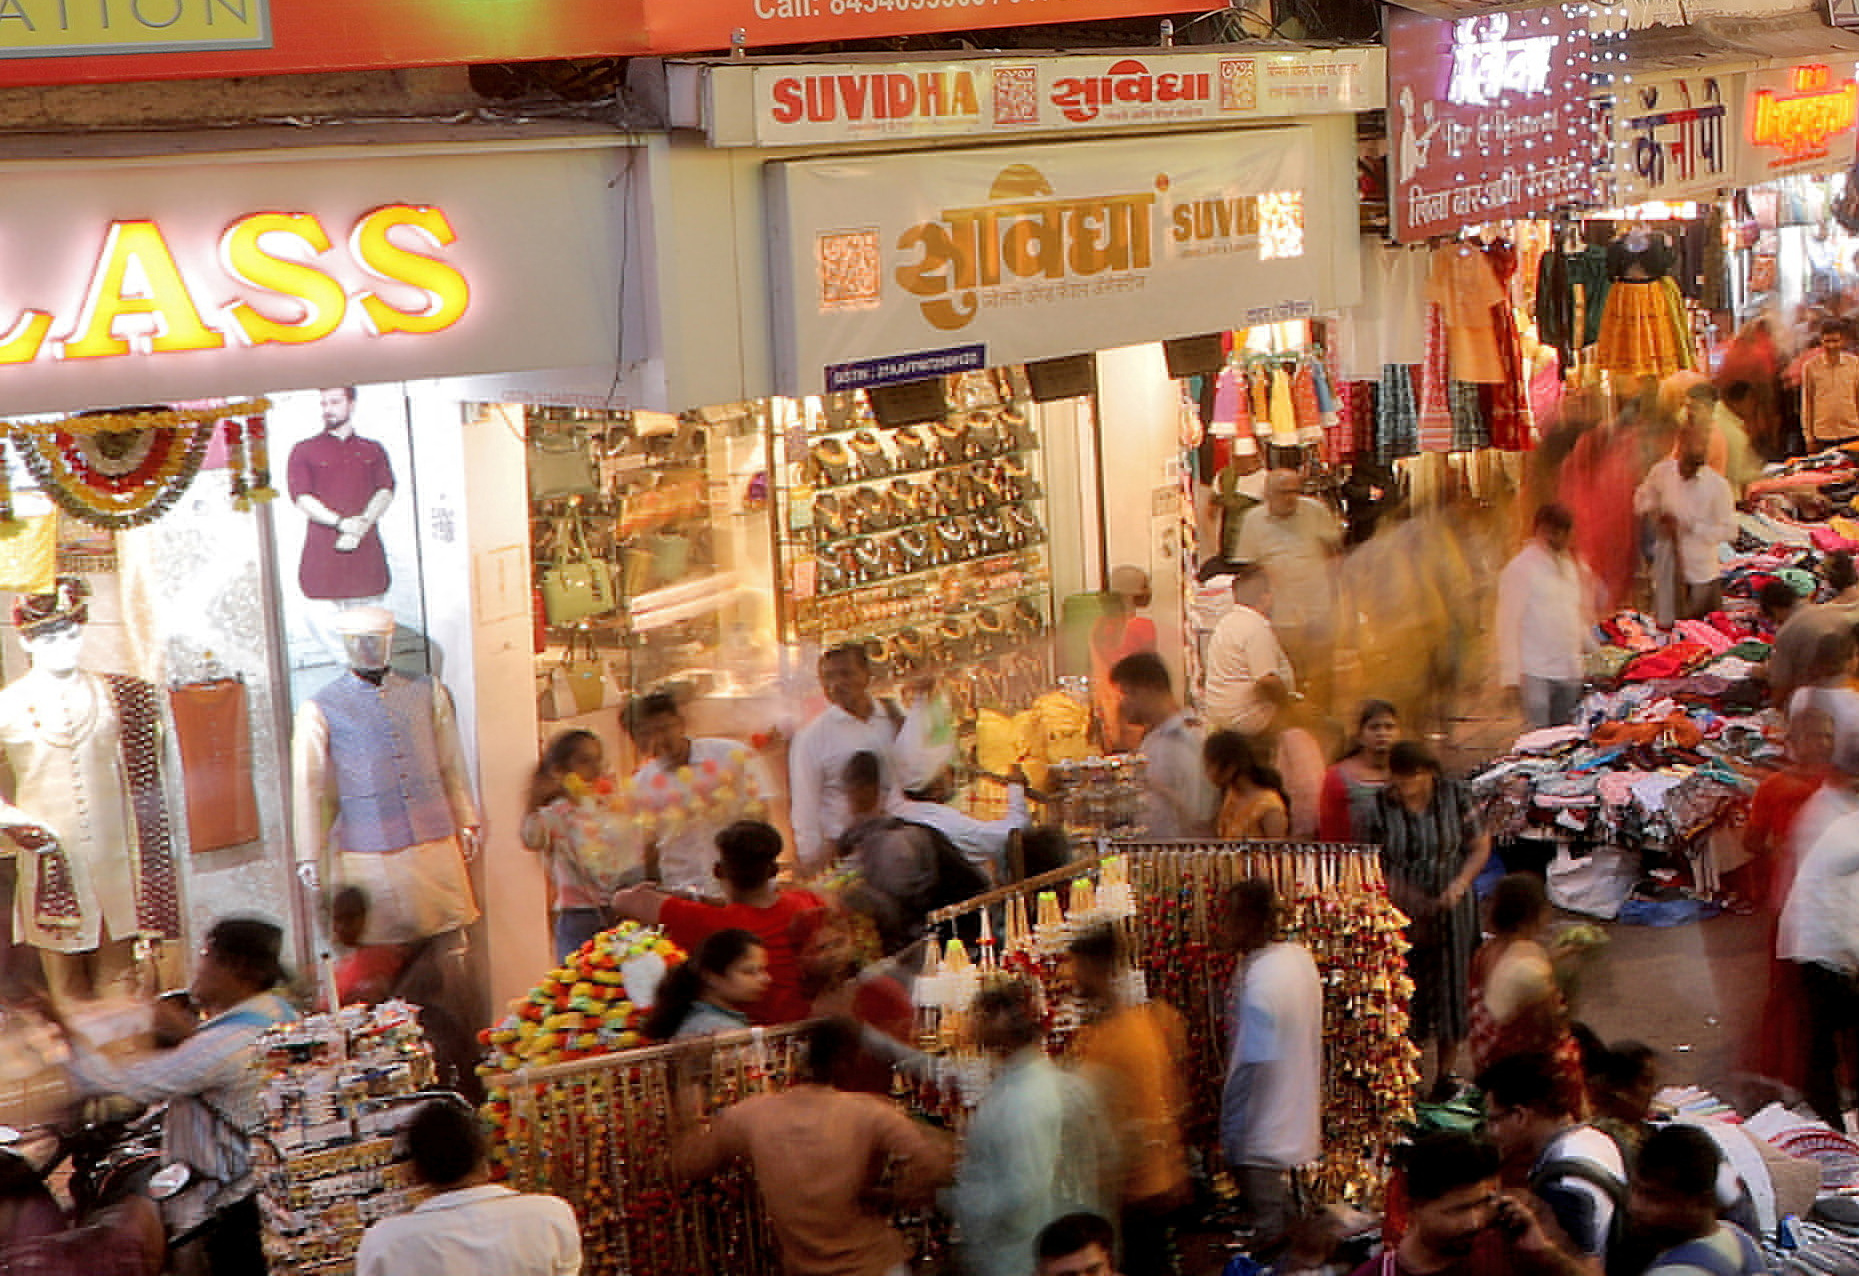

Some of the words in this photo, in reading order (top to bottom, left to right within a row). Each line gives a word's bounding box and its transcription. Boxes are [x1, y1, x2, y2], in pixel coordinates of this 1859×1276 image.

[772, 70, 979, 124] SUVIDHA
[1051, 59, 1211, 122] सुविधा
[895, 163, 1155, 331] सुविधा
